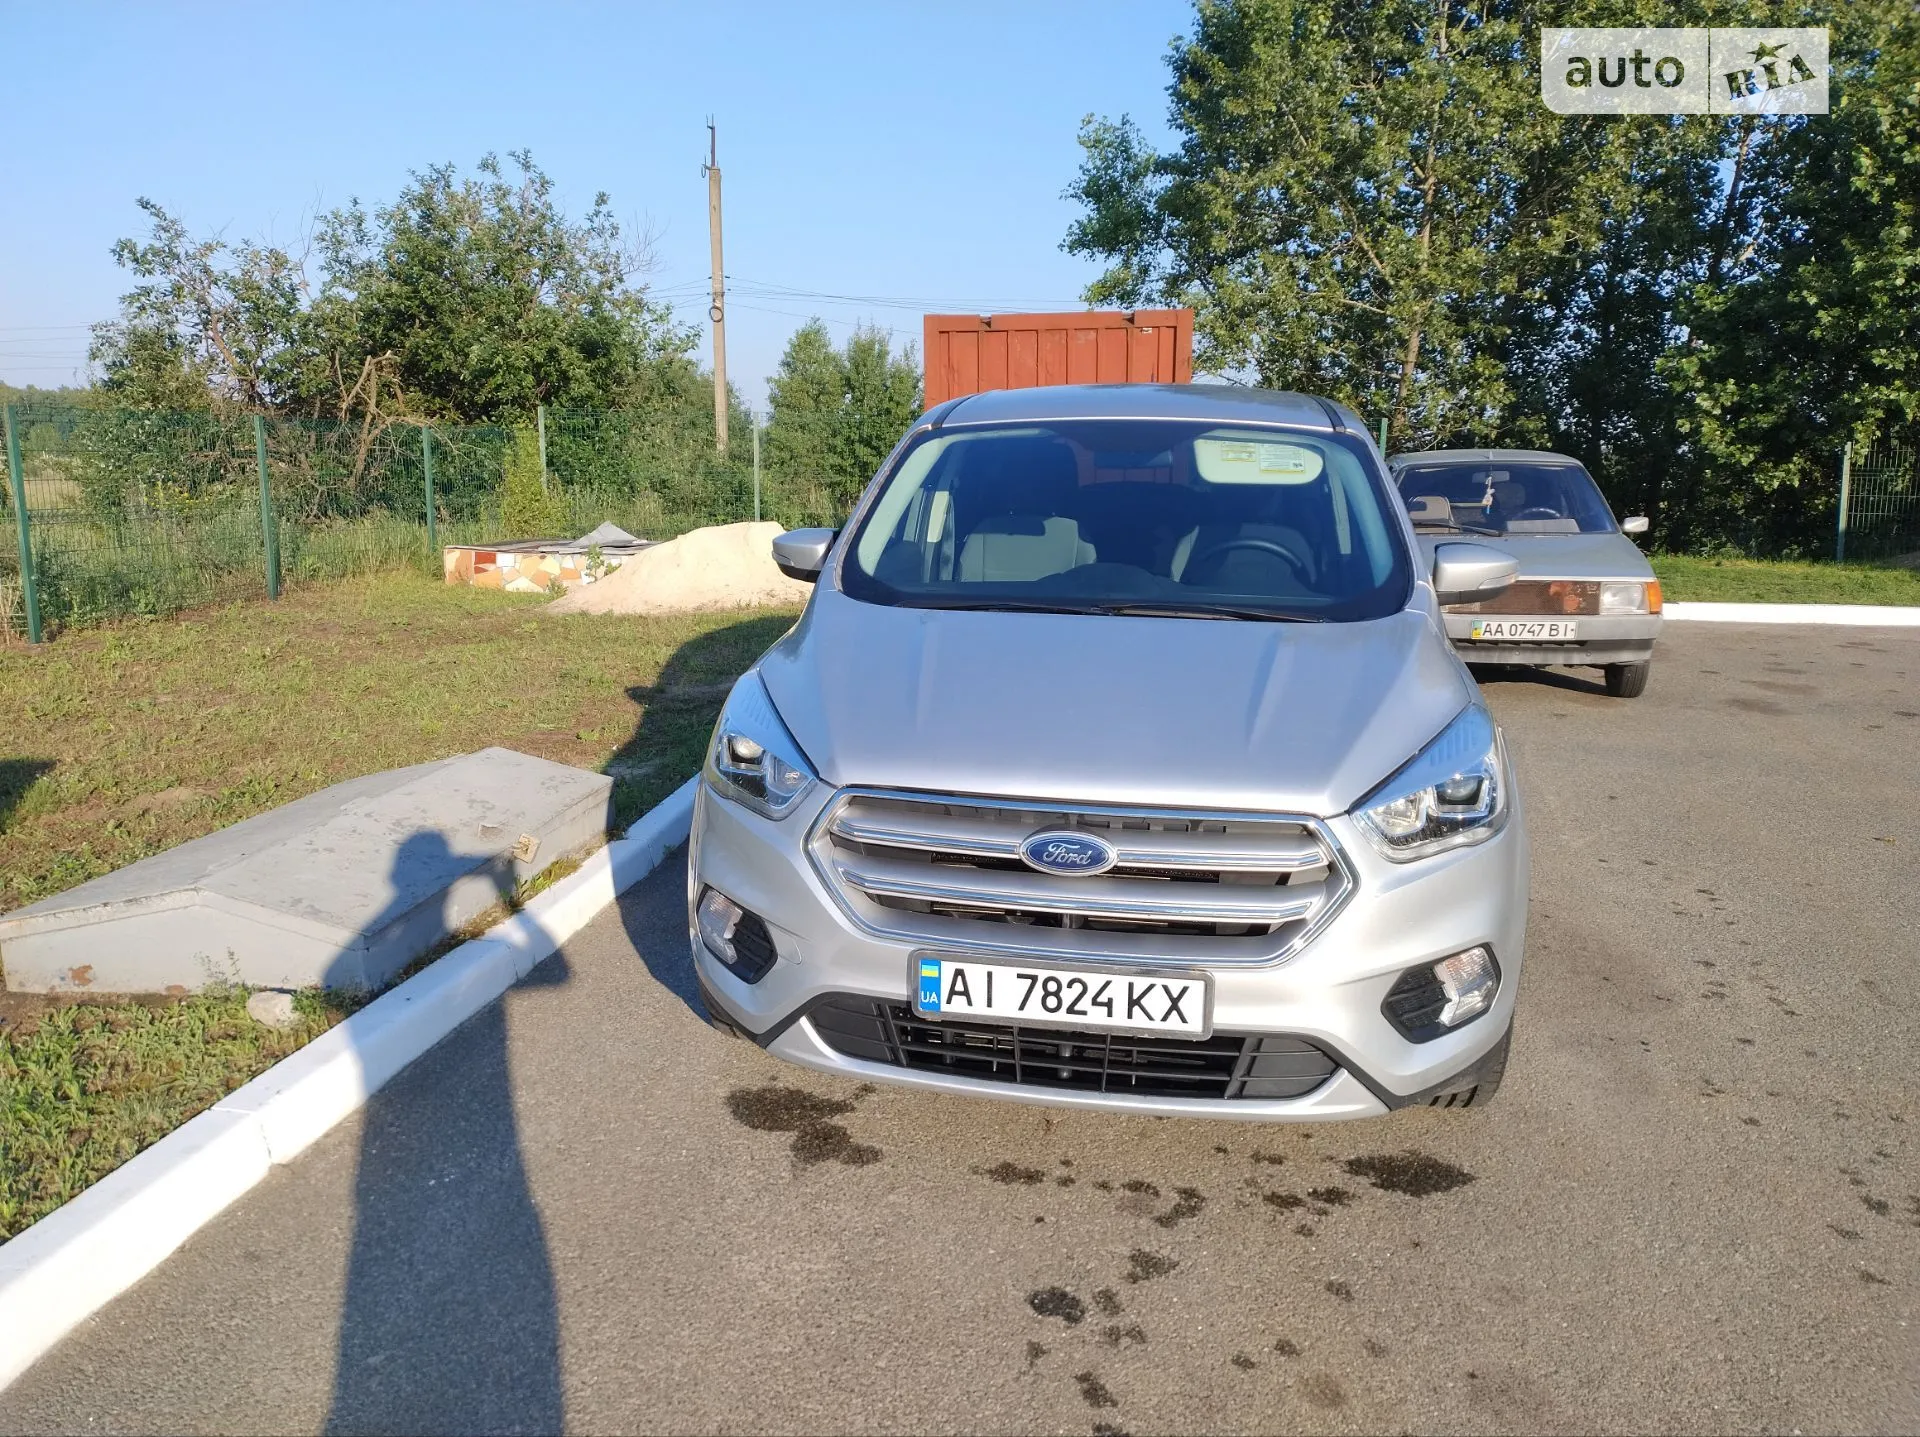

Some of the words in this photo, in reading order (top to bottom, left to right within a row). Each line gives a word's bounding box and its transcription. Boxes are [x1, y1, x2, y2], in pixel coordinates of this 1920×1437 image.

[1509, 623, 1544, 637] 0747
[1043, 842, 1093, 865] Ford
[921, 990, 938, 1004] UA
[946, 968, 993, 1008] AI
[1016, 973, 1113, 1018] 7824
[1127, 982, 1189, 1024] KX
